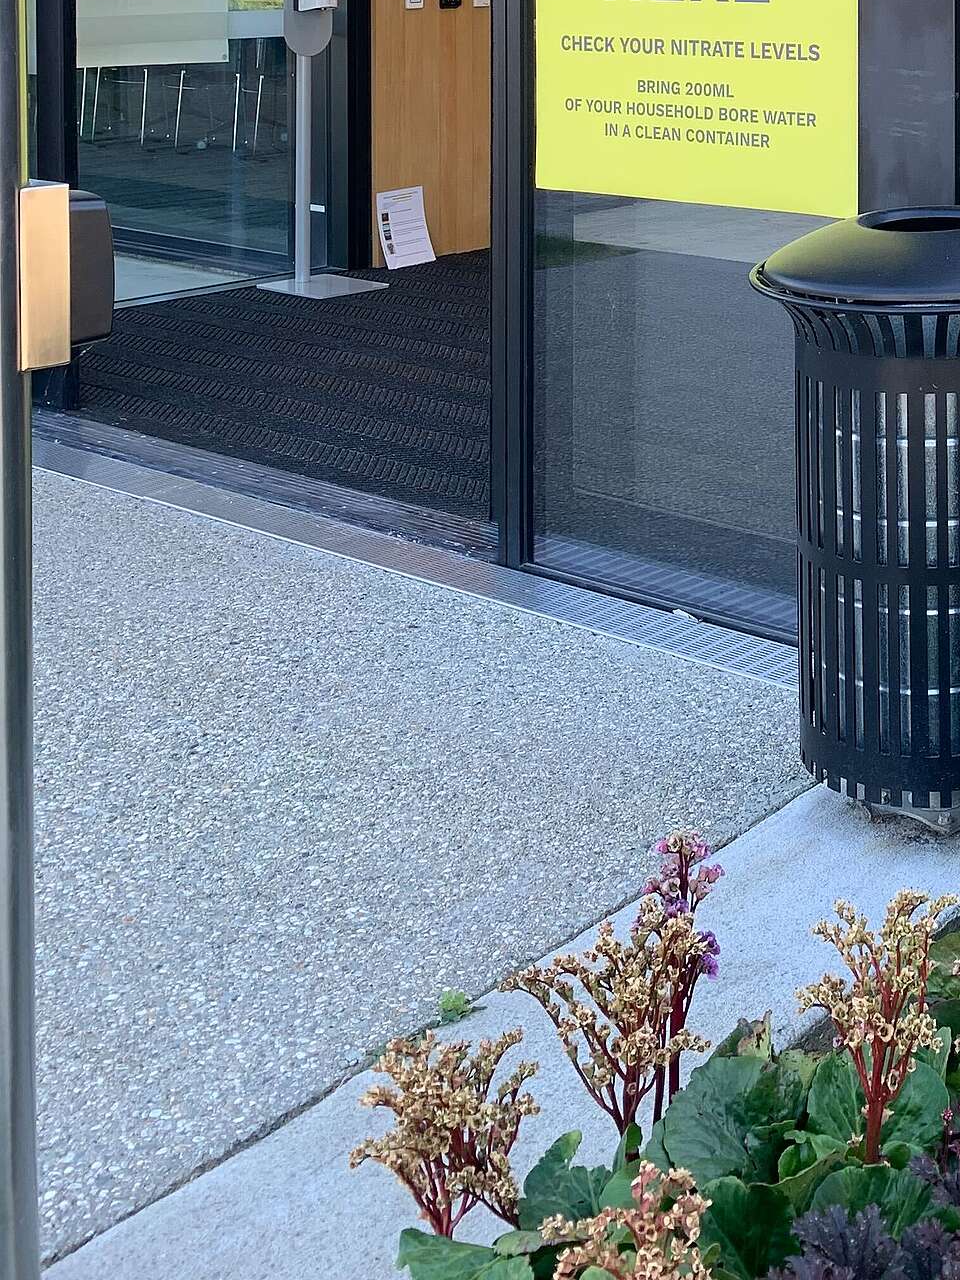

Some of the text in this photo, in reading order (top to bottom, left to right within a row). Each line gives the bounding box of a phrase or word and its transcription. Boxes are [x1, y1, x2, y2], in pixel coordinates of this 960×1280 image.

[561, 35, 820, 61] CHECK YOUR NITRATE LEVELS
[638, 80, 734, 98] BRING 200ML
[565, 98, 816, 127] OF YOUR HOUSEHOLD BORE WATER
[605, 123, 770, 148] IN A CLEAN CONTAINER
